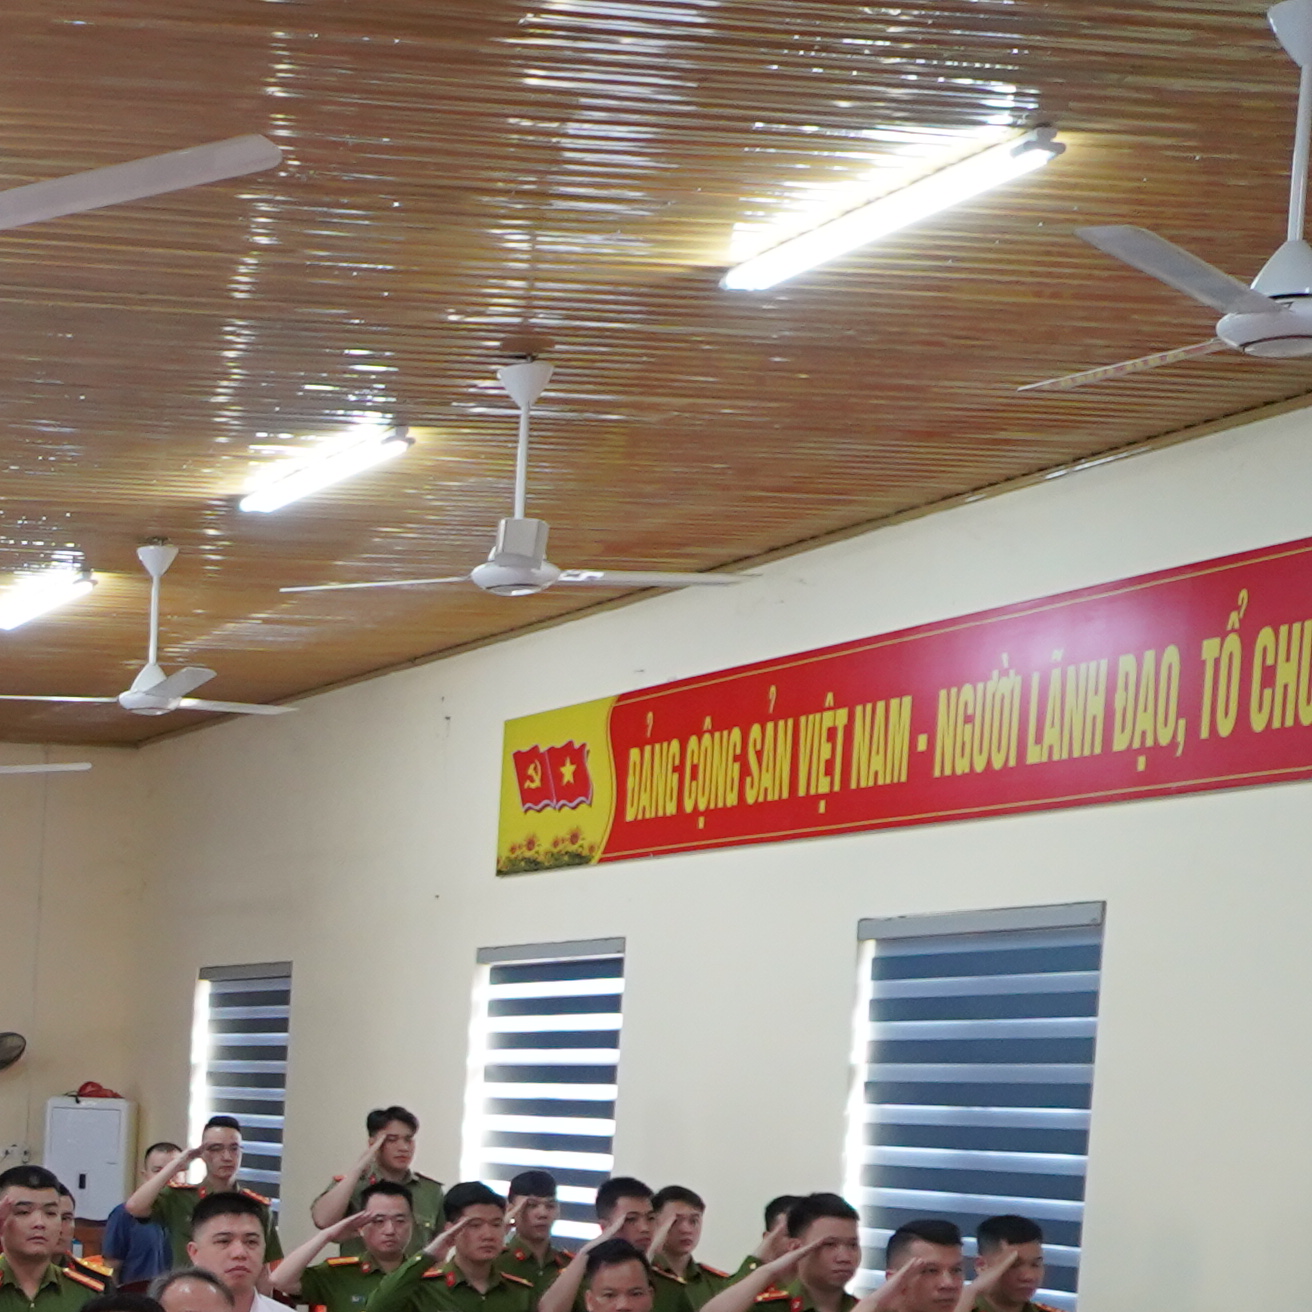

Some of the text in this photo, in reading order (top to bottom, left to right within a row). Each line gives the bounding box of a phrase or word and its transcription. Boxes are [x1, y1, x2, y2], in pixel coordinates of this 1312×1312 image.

[626, 711, 680, 822] ĐẢNG
[684, 716, 741, 829] CỘNG
[745, 685, 794, 804] SẢN
[798, 692, 848, 813] VIỆT
[850, 695, 912, 789] NAM
[933, 653, 1022, 778] NGƯỜI
[1026, 649, 1108, 765] LÃNH
[1112, 644, 1186, 771] ĐẠO,
[1200, 588, 1249, 739] TỔ
